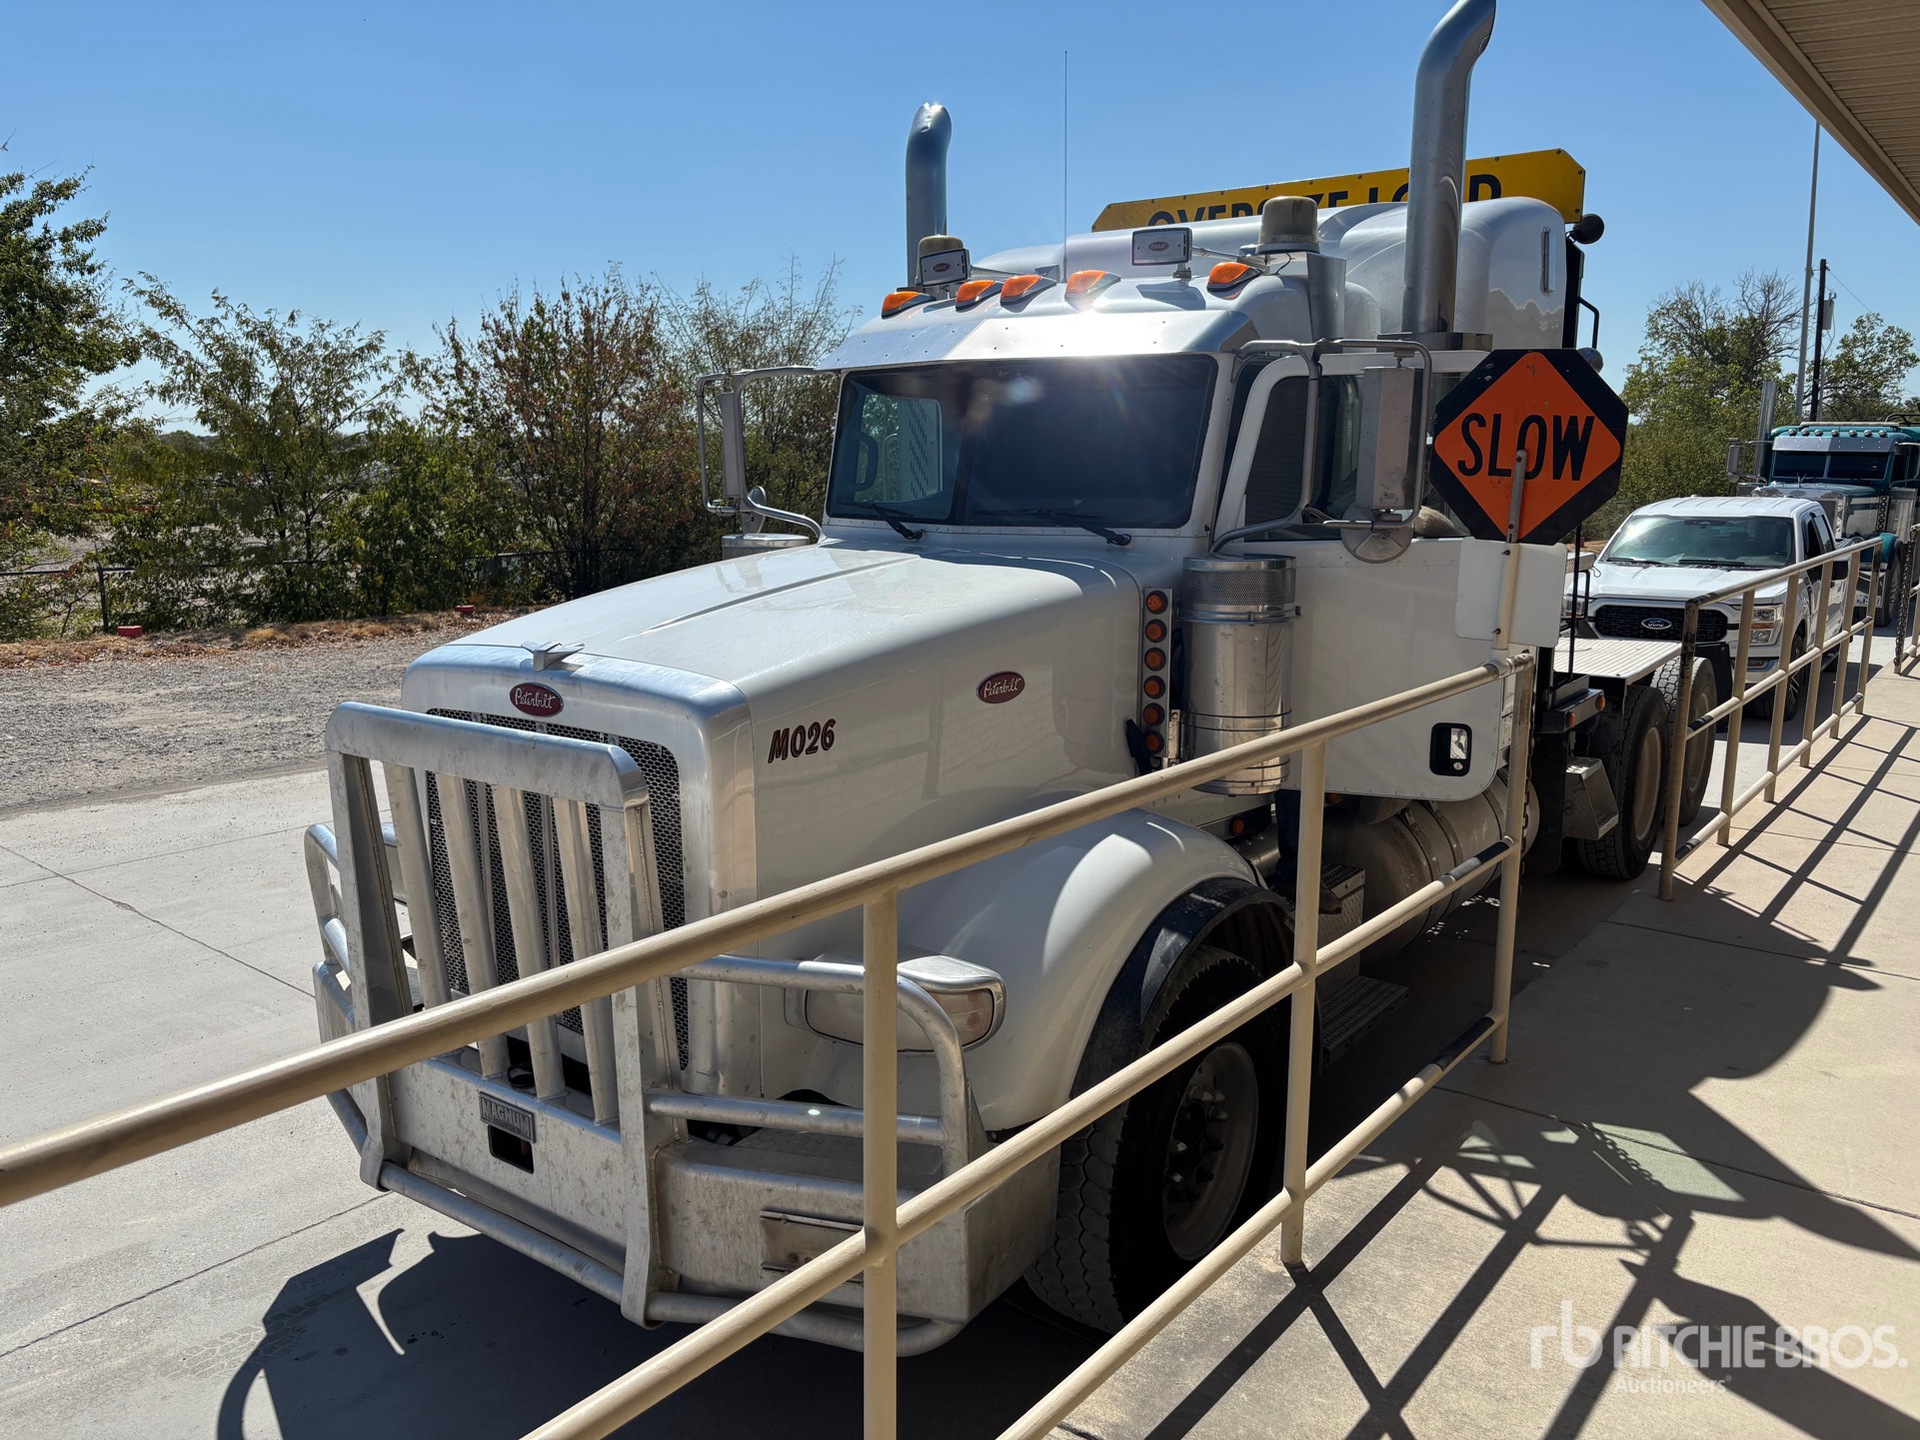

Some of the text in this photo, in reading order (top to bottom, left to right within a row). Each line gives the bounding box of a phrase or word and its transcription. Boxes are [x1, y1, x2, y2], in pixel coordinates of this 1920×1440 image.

[1457, 412, 1595, 481] SLOW
[515, 687, 556, 709] Peterbilt
[984, 677, 1022, 699] Peterbilt
[481, 1096, 531, 1139] MAGNUM
